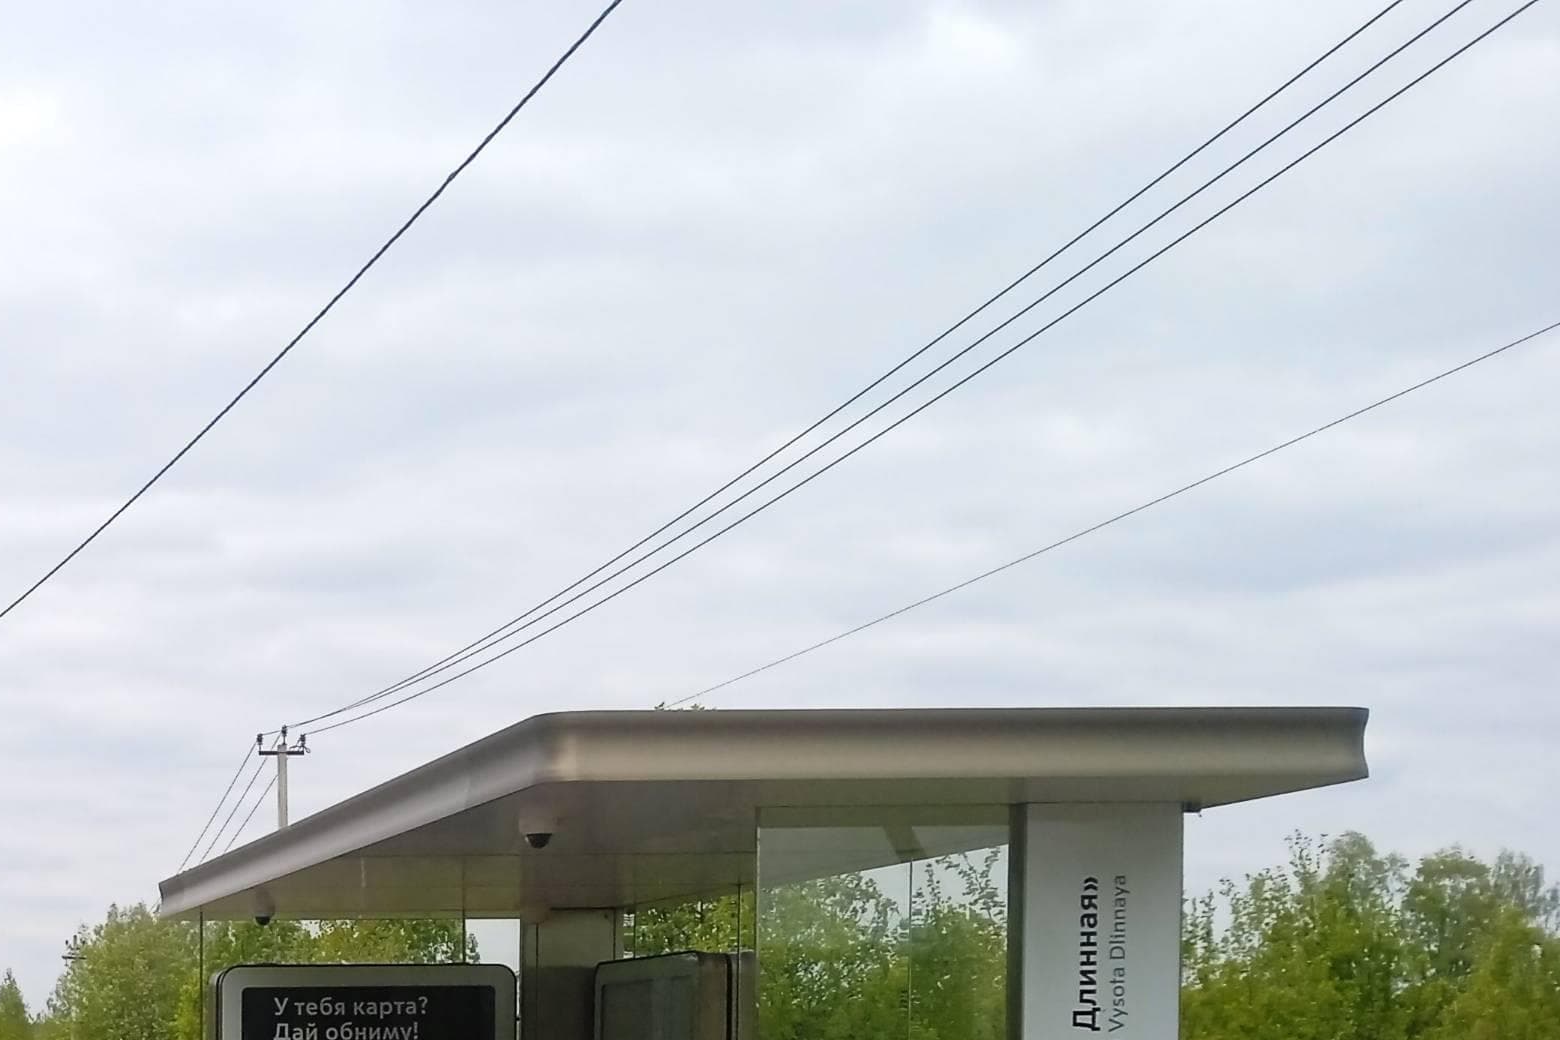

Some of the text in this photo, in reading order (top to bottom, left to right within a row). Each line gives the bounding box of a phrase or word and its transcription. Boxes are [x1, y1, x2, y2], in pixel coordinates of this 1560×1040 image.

[1071, 875, 1101, 1032] Длинная»
[1109, 874, 1131, 960] Dlinnaya
[273, 996, 428, 1019] У тебя карта?
[1108, 967, 1128, 1033] Vysota
